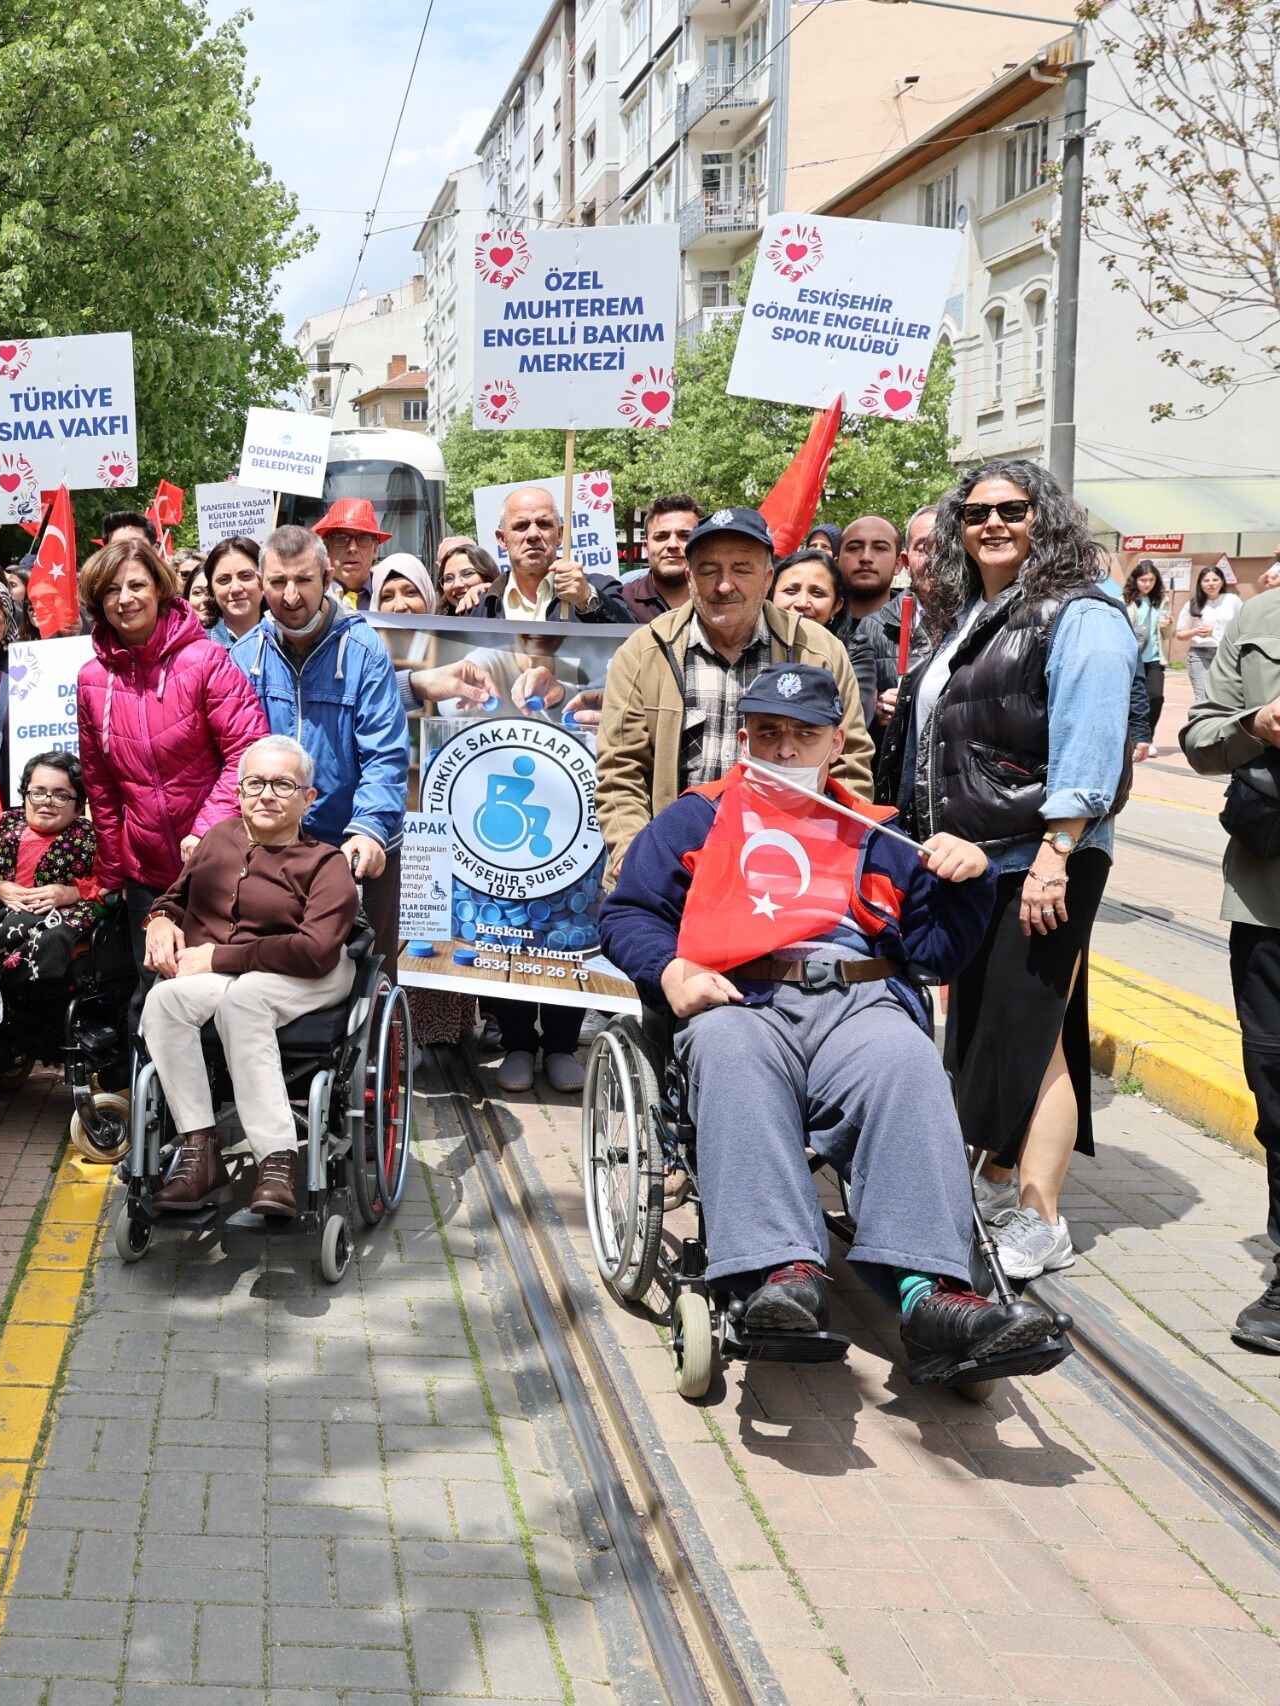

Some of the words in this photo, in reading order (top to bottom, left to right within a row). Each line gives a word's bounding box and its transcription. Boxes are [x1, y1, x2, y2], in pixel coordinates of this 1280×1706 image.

[544, 267, 604, 291] ÖZEL
[503, 296, 644, 320] MUHTEREM
[797, 287, 893, 314] ESKİŞEHİR
[751, 301, 821, 325] GÖRME
[823, 312, 931, 340] ENGELLİLER
[483, 321, 576, 348] ENGELLİ
[583, 323, 665, 344] BAKIM
[771, 326, 821, 346] SPOR
[824, 333, 900, 356] KULÜBÜ
[518, 346, 625, 373] MERKEZİ
[10, 384, 112, 413] TÜRKİYE
[58, 415, 128, 438] VAKFI
[247, 445, 322, 464] ODUNPAZARI
[251, 457, 315, 476] BELEDİYESİ
[200, 500, 241, 512] KANSERLE
[242, 498, 271, 509] YAŞAM
[208, 510, 238, 521] KÜLTÜR
[239, 508, 265, 517] SANAT
[208, 517, 237, 530] EĞİTİM
[238, 517, 266, 528] SAĞLIK
[221, 527, 255, 538] DERNEĞİ
[429, 747, 466, 813] TÜRKİYE
[466, 727, 570, 759] SAKATLAR
[525, 855, 579, 889] ŞUBESİ
[487, 882, 527, 899] 1975
[400, 903, 418, 911] TLAR
[476, 924, 534, 940] Başkan
[475, 940, 522, 955] Ecevit
[526, 946, 584, 963] Yılancı
[473, 957, 510, 971] 0534
[515, 961, 543, 975] 356
[547, 965, 566, 978] 26
[570, 969, 589, 981] 75
